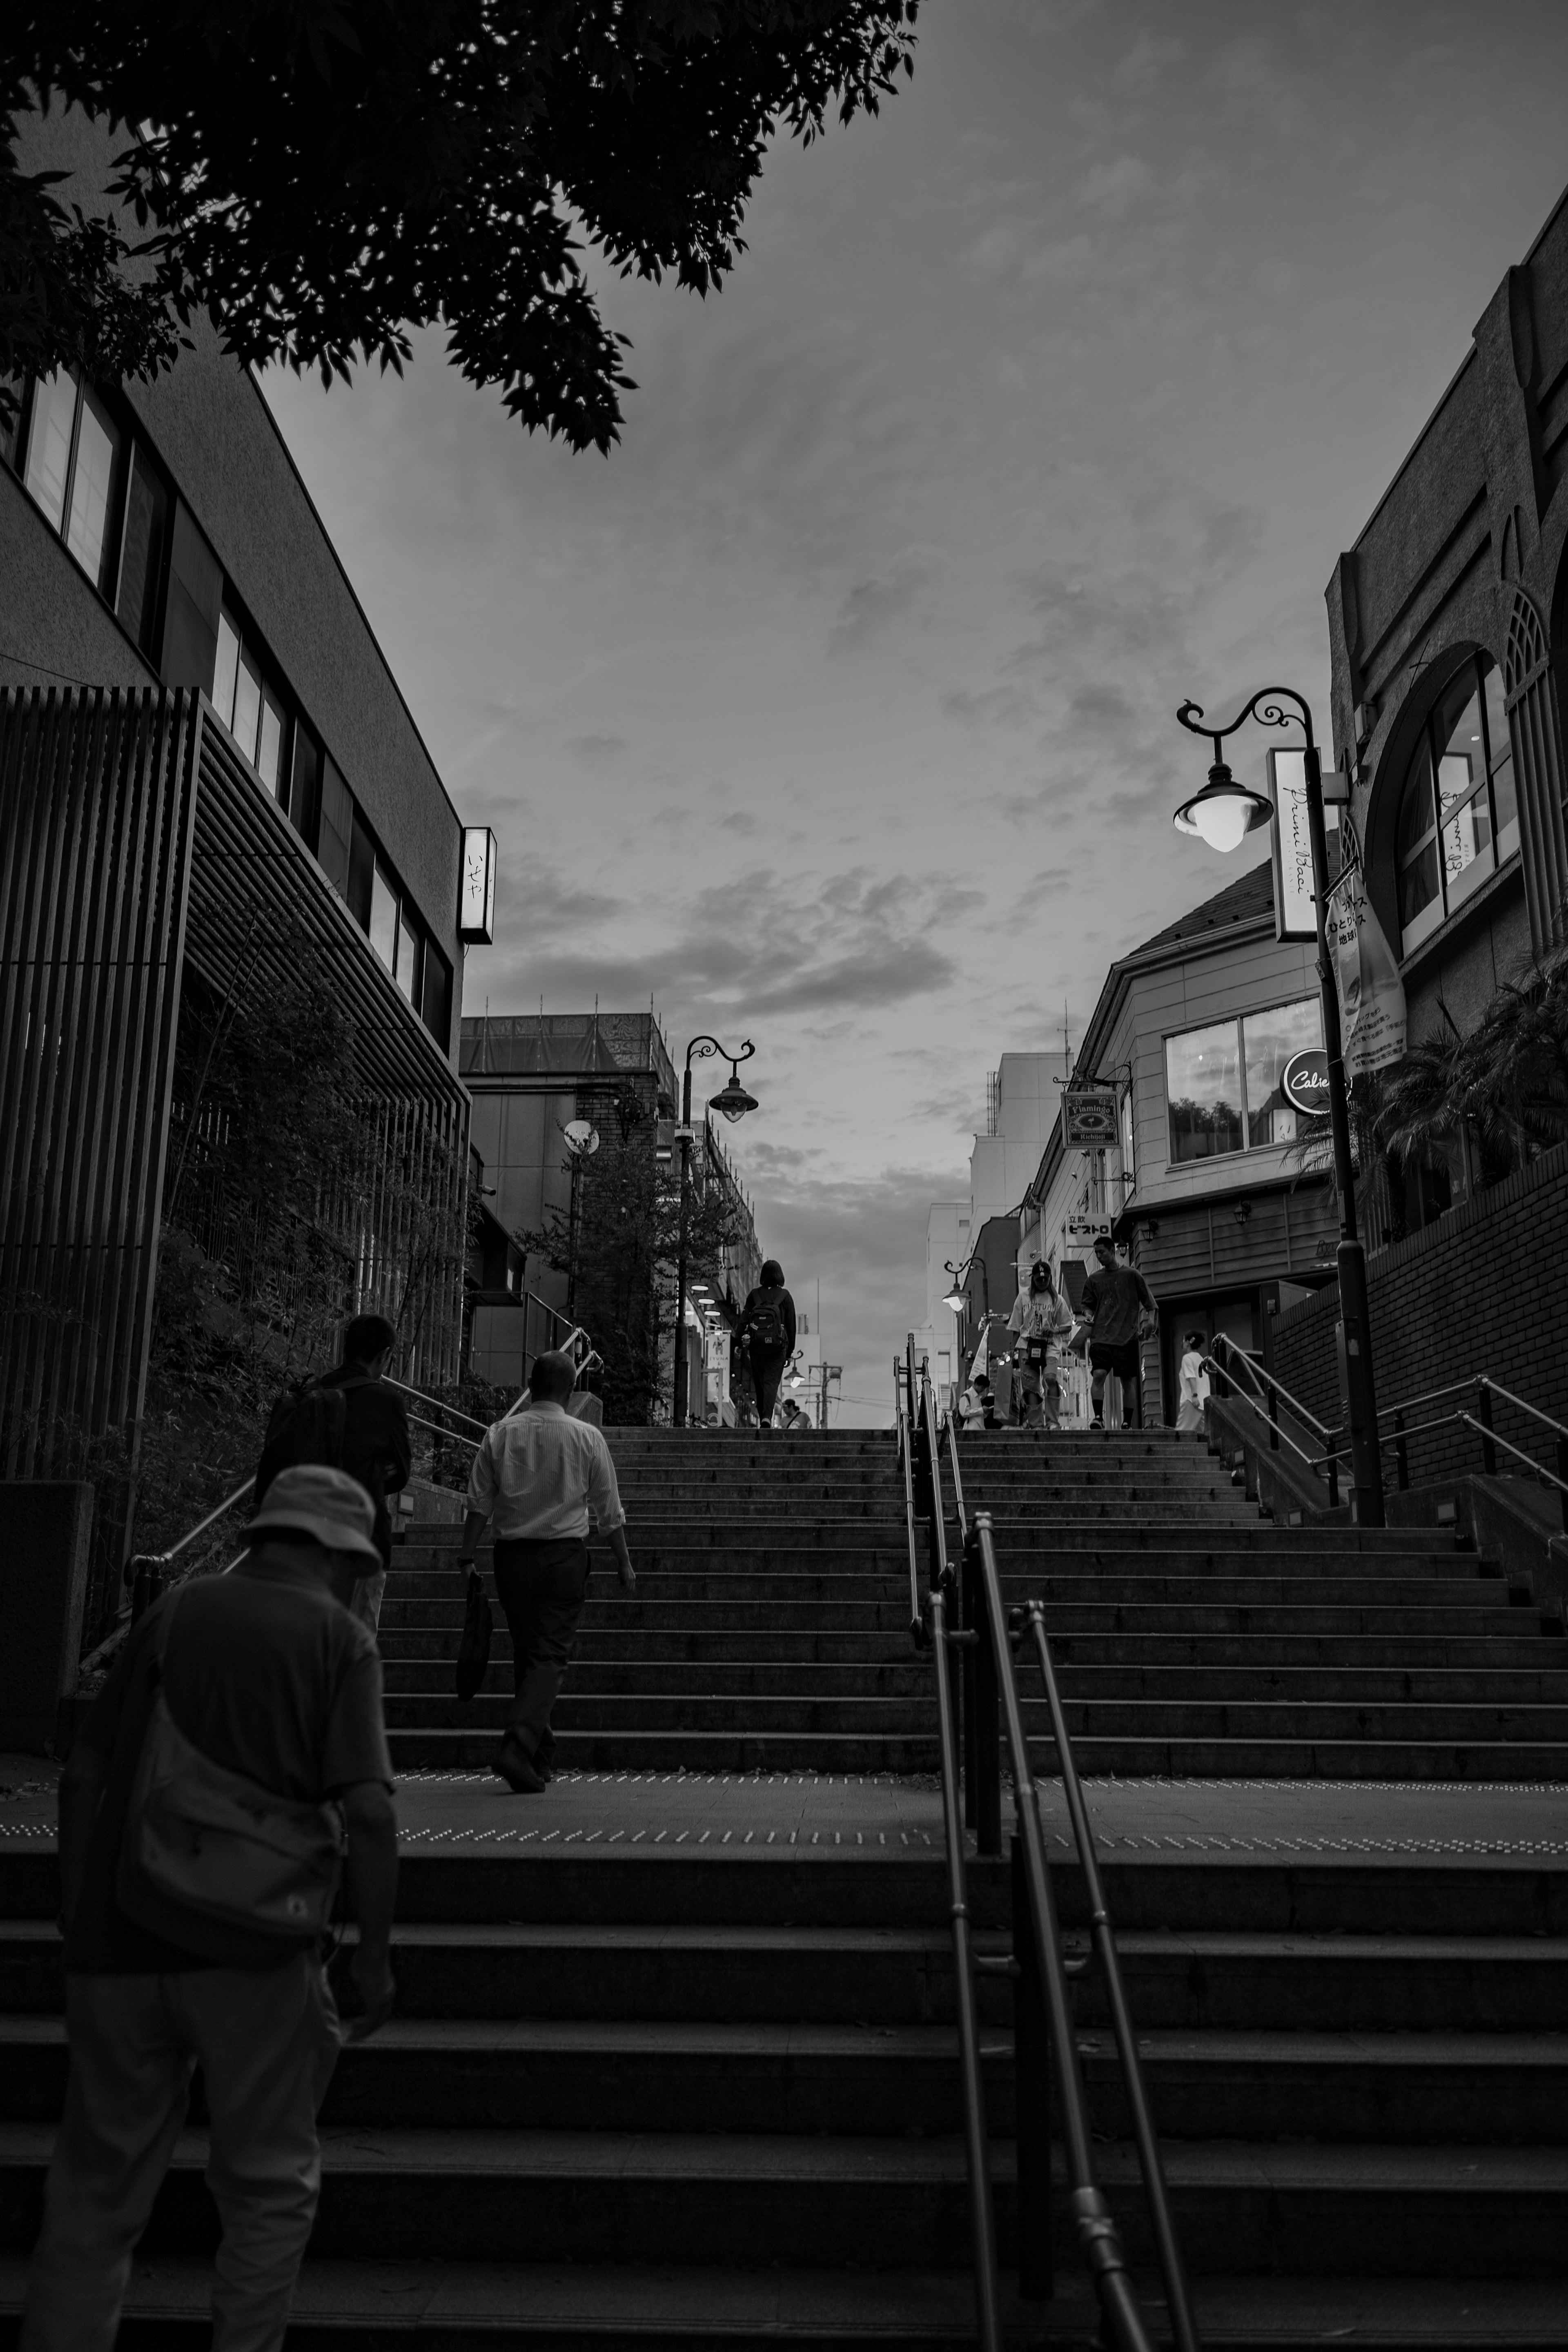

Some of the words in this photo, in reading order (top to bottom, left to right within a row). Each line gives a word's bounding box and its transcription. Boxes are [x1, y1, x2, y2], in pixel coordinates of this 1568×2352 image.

[468, 855, 483, 899] いせや
[1296, 851, 1313, 894] Baci
[1291, 1070, 1330, 1090] Calie
[1072, 1105, 1110, 1115] Flamingo
[1069, 1225, 1109, 1234] ビストロ
